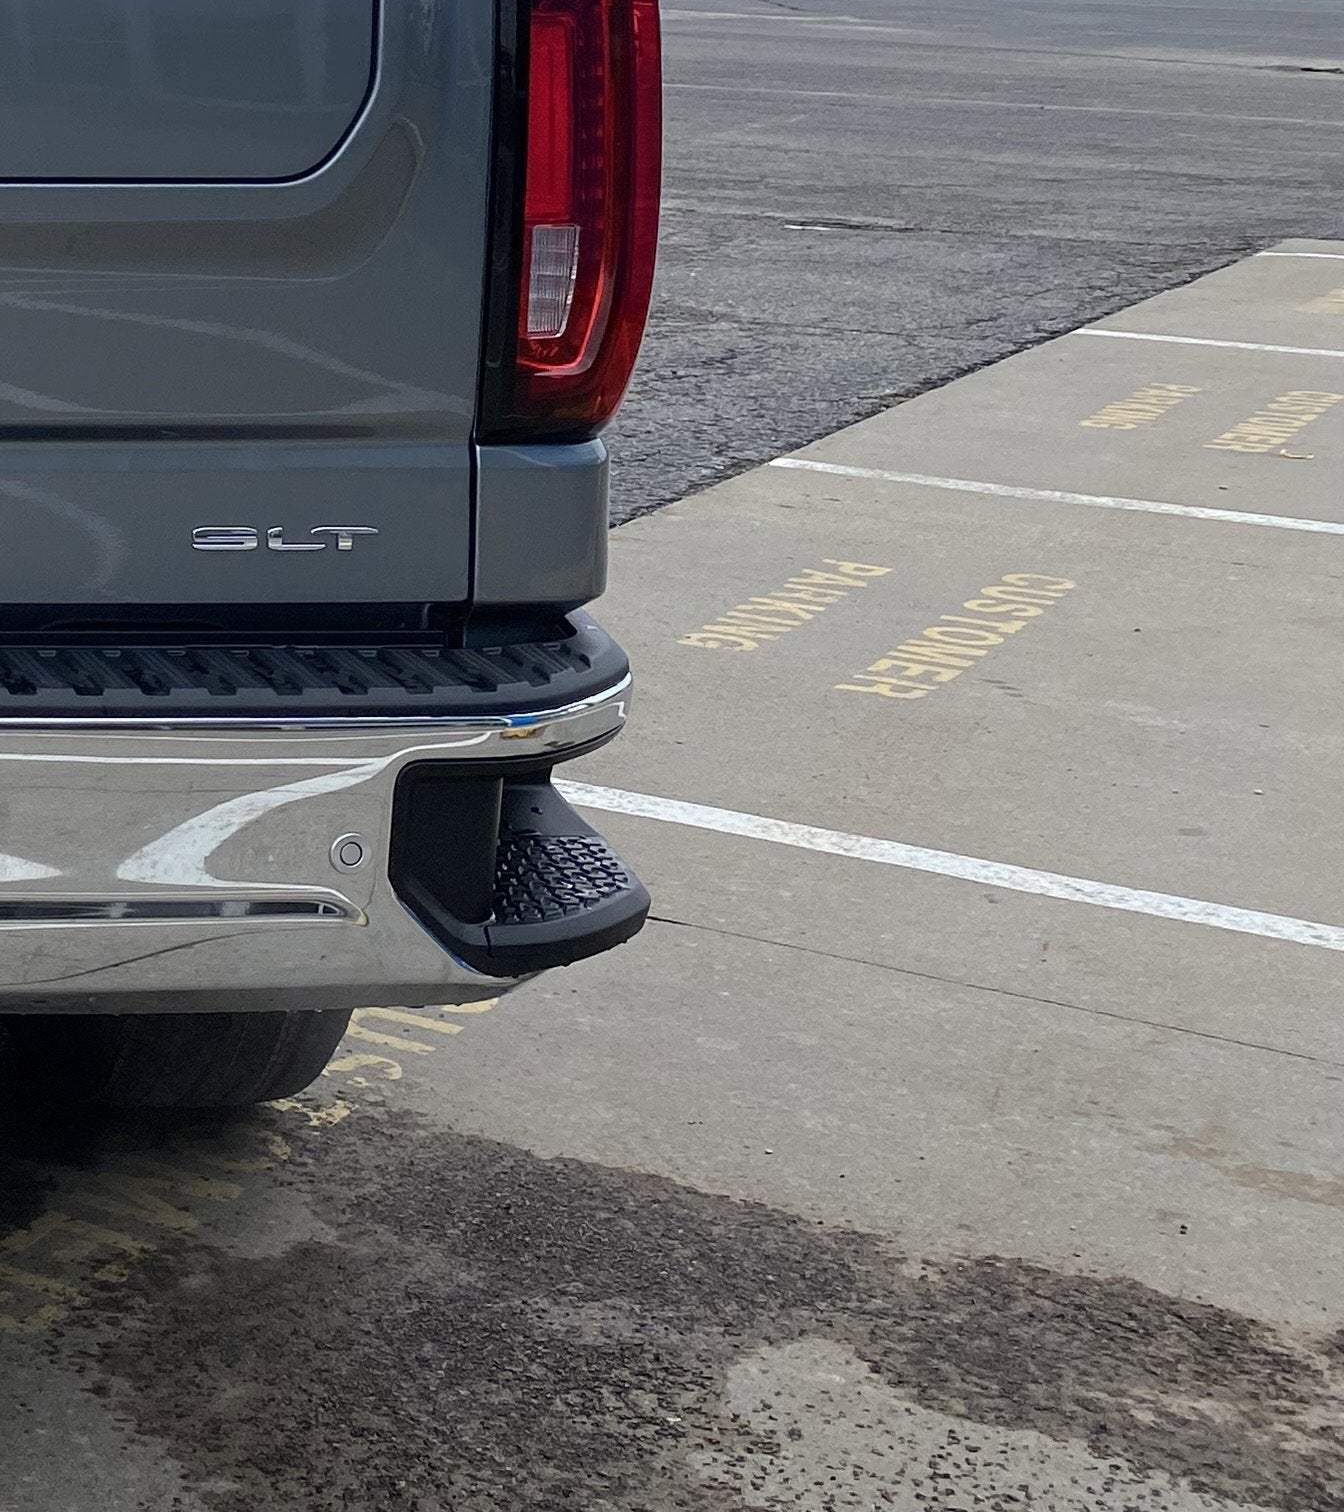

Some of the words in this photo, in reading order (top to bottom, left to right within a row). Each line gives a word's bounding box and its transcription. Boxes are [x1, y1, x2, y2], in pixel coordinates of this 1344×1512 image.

[1078, 382, 1203, 430] PARKING
[1202, 390, 1344, 453] CUSTOMER
[191, 526, 380, 551] SLT
[677, 559, 892, 652] PARKING
[834, 573, 1077, 699] CUSTOMER
